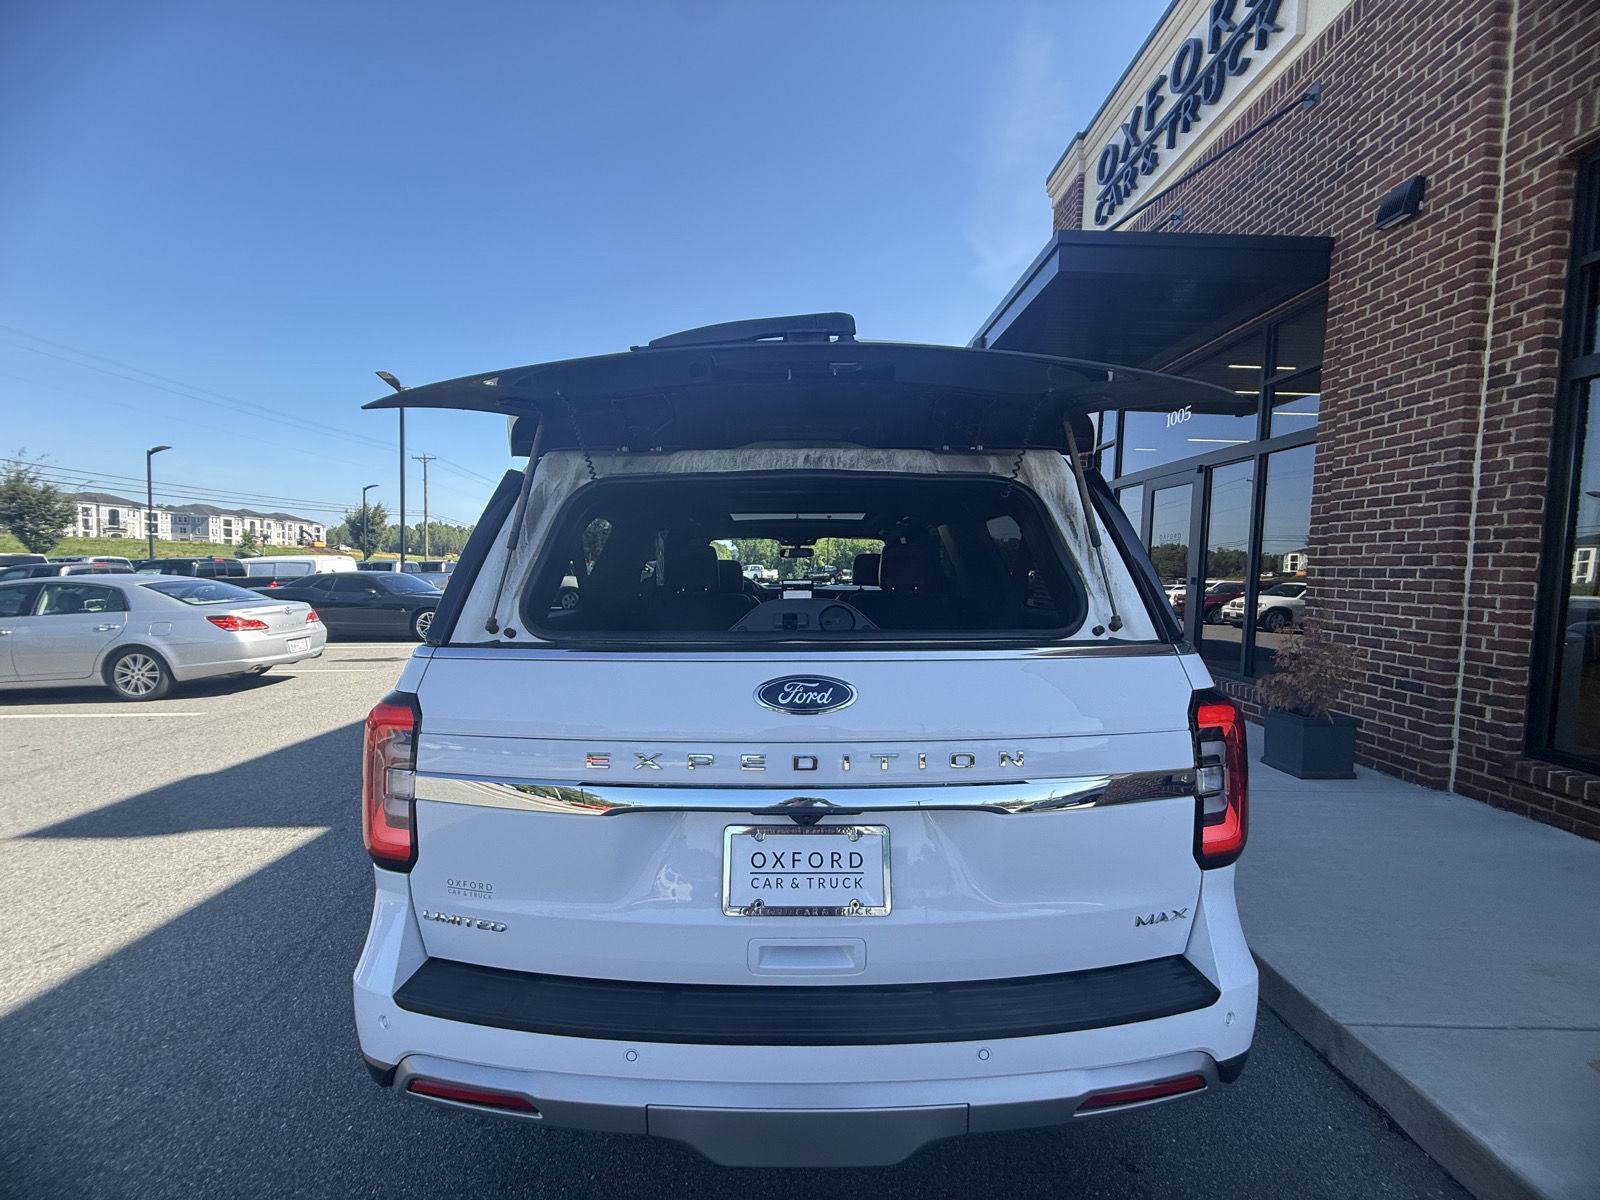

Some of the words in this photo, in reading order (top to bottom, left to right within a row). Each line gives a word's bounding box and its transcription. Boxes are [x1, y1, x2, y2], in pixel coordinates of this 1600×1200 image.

[1096, 0, 1259, 186] OXFOR
[1094, 164, 1140, 226] CAR
[1162, 0, 1284, 150] TRUCK
[1166, 404, 1192, 428] 1005
[778, 681, 834, 704] Ford
[585, 751, 1025, 772] EXPEDITION
[750, 851, 864, 869] OXFORD
[447, 878, 493, 891] OXFORD
[750, 877, 784, 889] CAR
[790, 877, 800, 889] &
[806, 877, 864, 889] TRUCK
[447, 888, 461, 896] CAR
[469, 891, 493, 900] TRUCK
[423, 910, 507, 932] LIMITED
[1135, 906, 1189, 927] MAX
